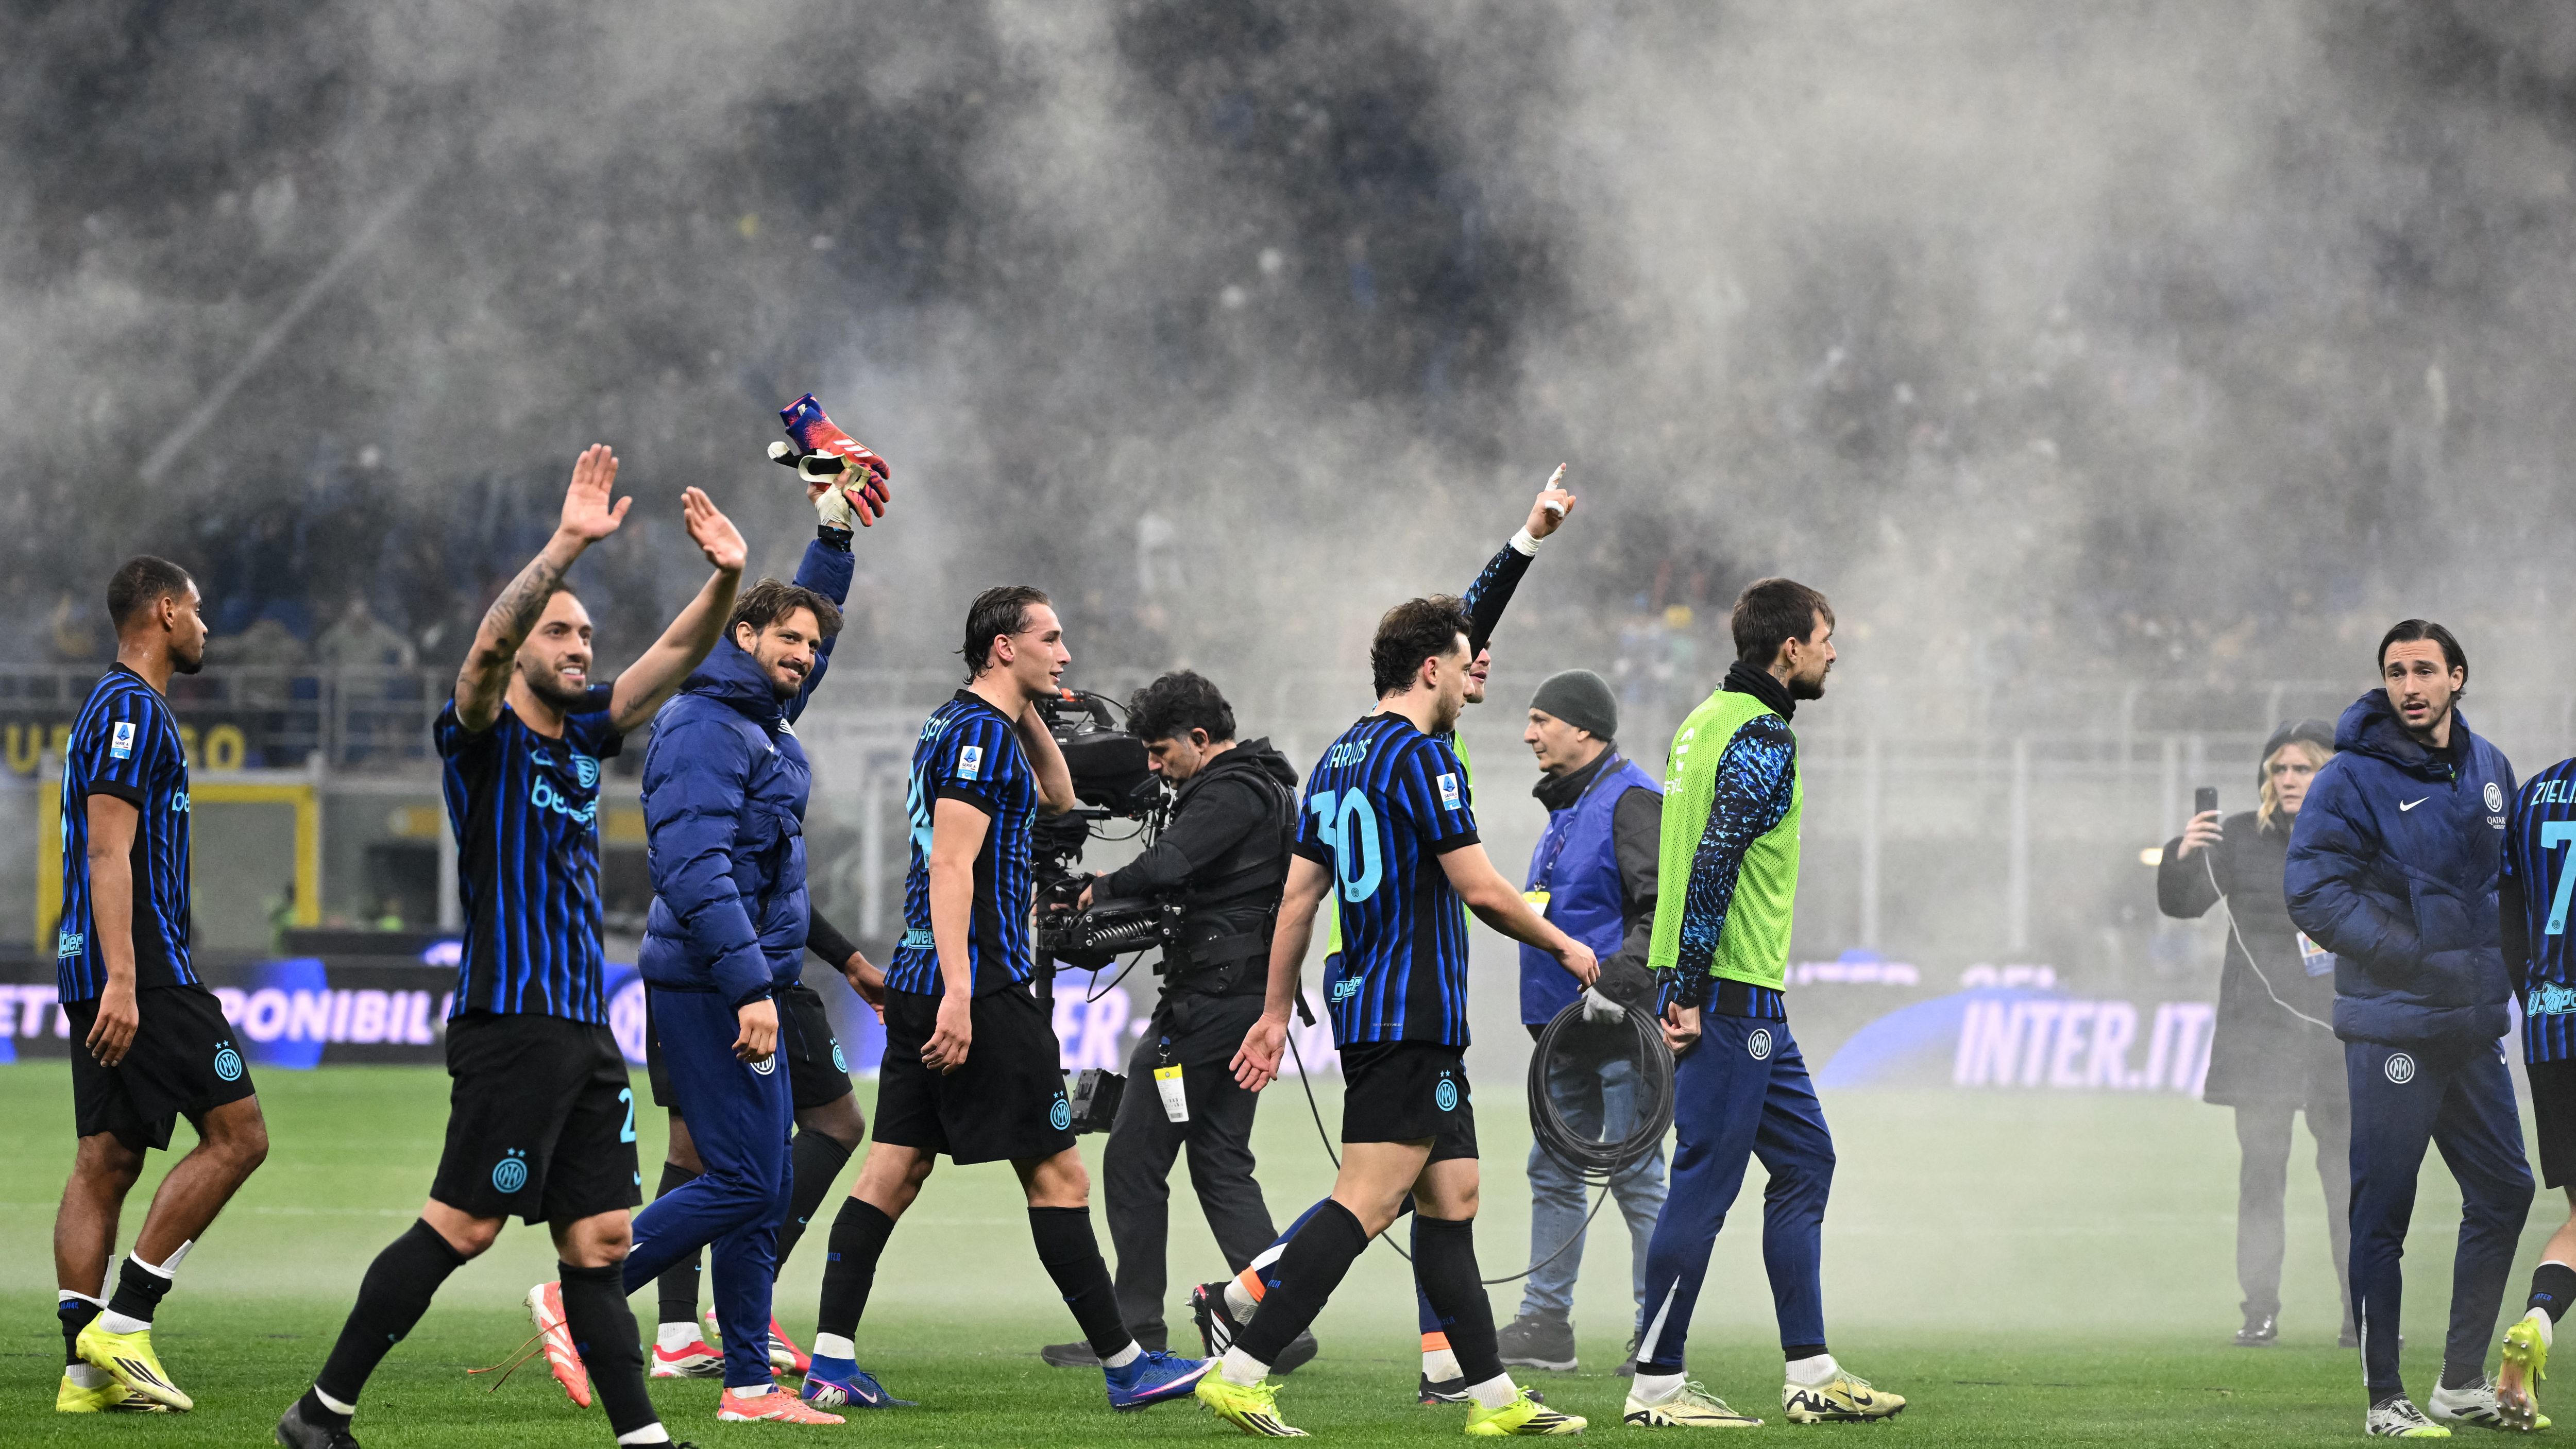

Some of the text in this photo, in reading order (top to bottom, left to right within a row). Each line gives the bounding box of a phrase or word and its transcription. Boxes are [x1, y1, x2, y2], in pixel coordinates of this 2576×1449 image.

[1324, 738, 1372, 770] CARLOS
[2487, 816, 2505, 825] QATAR
[2530, 780, 2576, 806] ZIELI
[1310, 786, 1383, 903] 30
[2540, 821, 2576, 935] 7
[1954, 1000, 2215, 1093] INTER.IT
